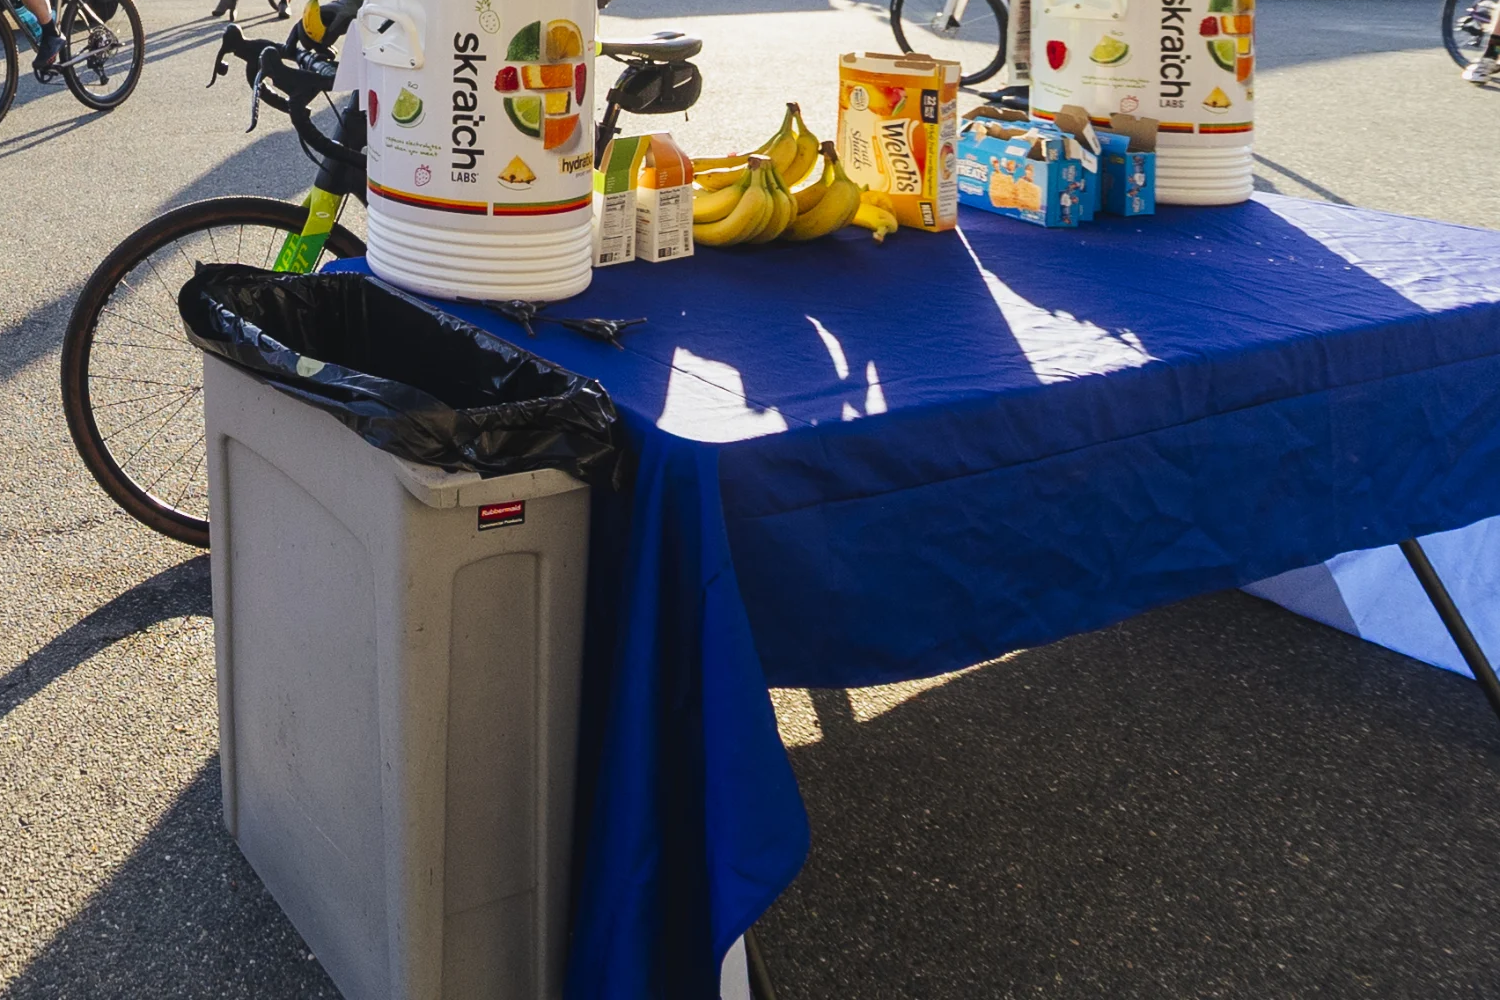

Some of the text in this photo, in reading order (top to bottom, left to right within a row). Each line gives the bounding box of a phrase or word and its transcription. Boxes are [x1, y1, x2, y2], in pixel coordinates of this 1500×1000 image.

[451, 31, 487, 169] skratch
[928, 96, 937, 106] 22
[1159, 99, 1184, 109] LABS
[850, 127, 862, 171] Snacks
[881, 121, 917, 194] Welch's
[451, 172, 479, 184] LABS
